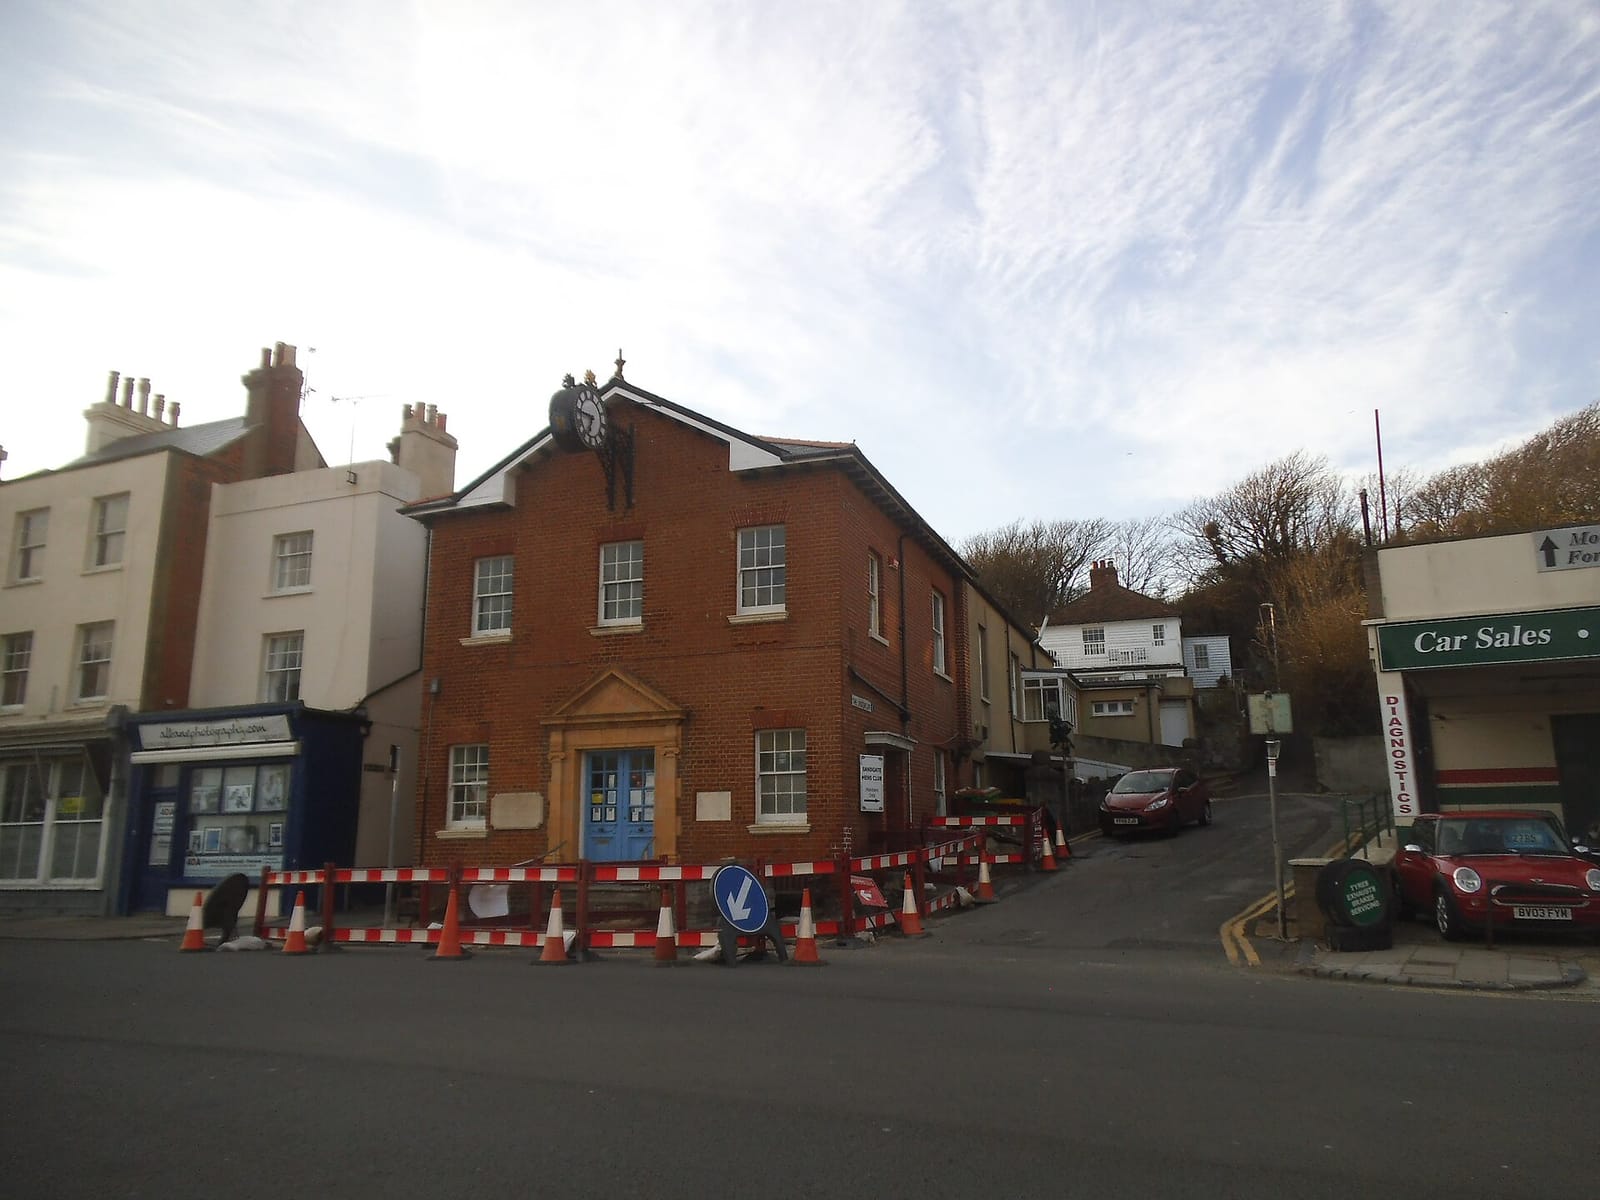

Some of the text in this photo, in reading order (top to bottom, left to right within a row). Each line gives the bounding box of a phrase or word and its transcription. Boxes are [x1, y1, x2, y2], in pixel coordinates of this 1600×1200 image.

[1414, 625, 1552, 653] Car Sales
[1386, 696, 1412, 814] DIAGNOSTICS
[1350, 880, 1369, 891] TYRES
[1346, 886, 1376, 901] EXHAUSTS
[1351, 894, 1375, 907] BRAKES
[1350, 900, 1380, 916] SERVICING
